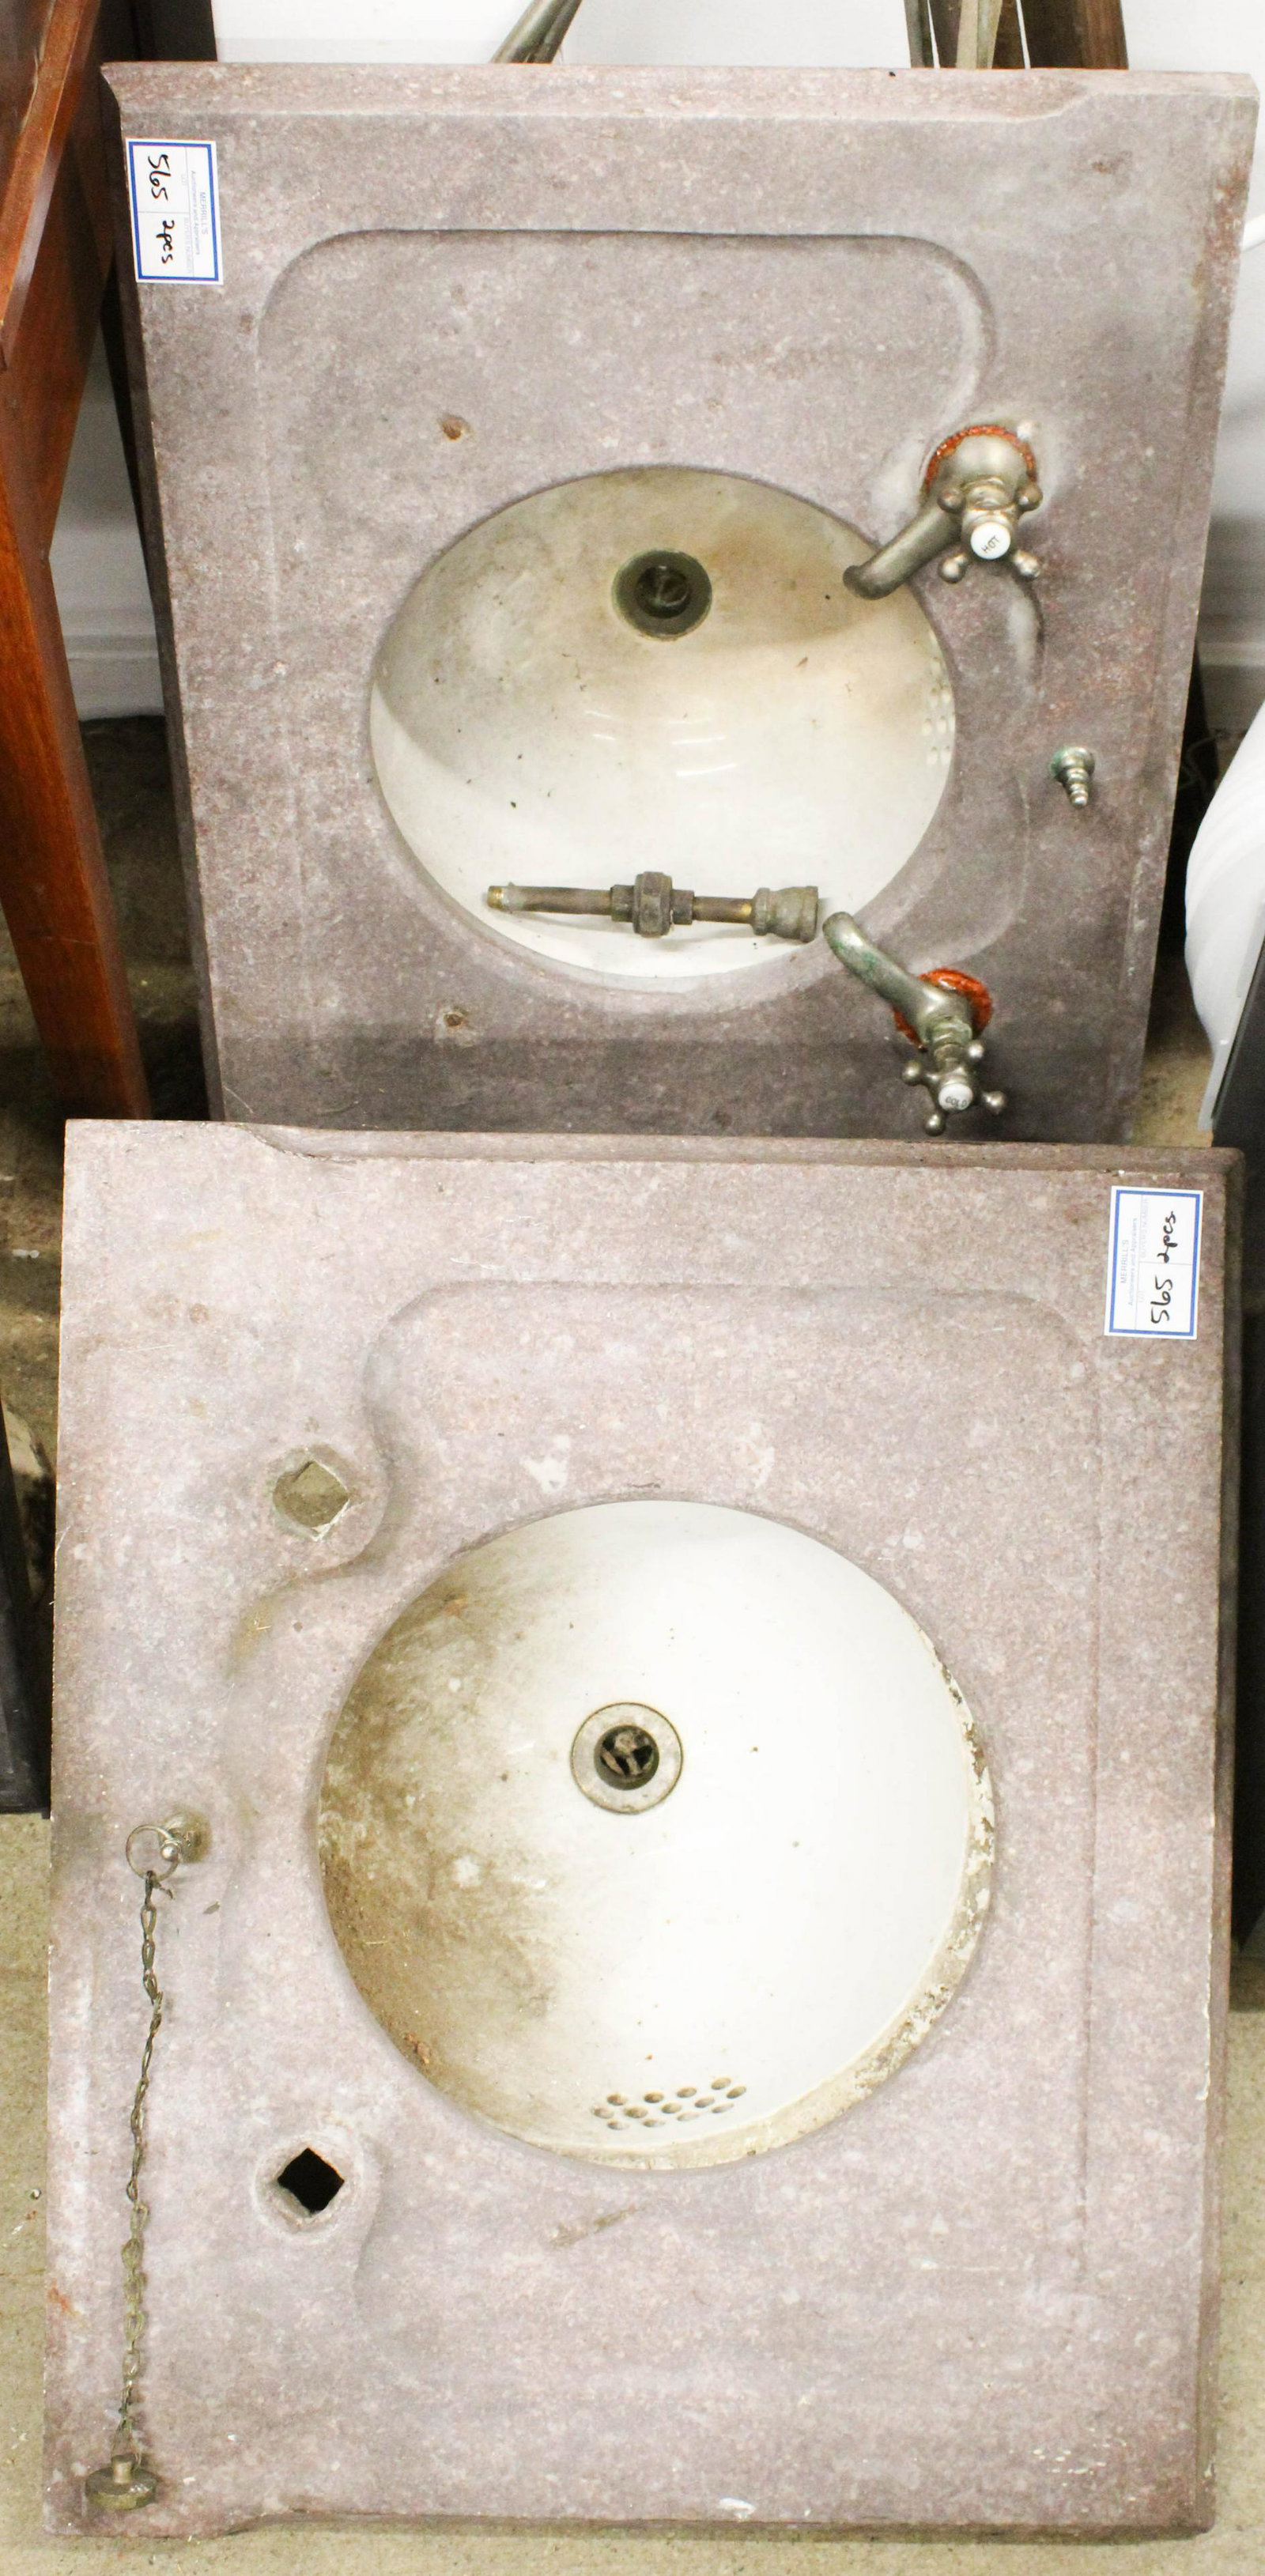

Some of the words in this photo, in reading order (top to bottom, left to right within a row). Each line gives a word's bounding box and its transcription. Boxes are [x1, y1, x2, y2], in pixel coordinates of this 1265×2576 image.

[148, 154, 172, 202] 565
[199, 191, 209, 235] MERRILL'S
[156, 220, 175, 264] 2pcs
[981, 534, 1000, 553] HOT
[945, 1096, 968, 1108] COLD
[1120, 1239, 1129, 1284] MERRILL'S
[1150, 1275, 1173, 1324] 565
